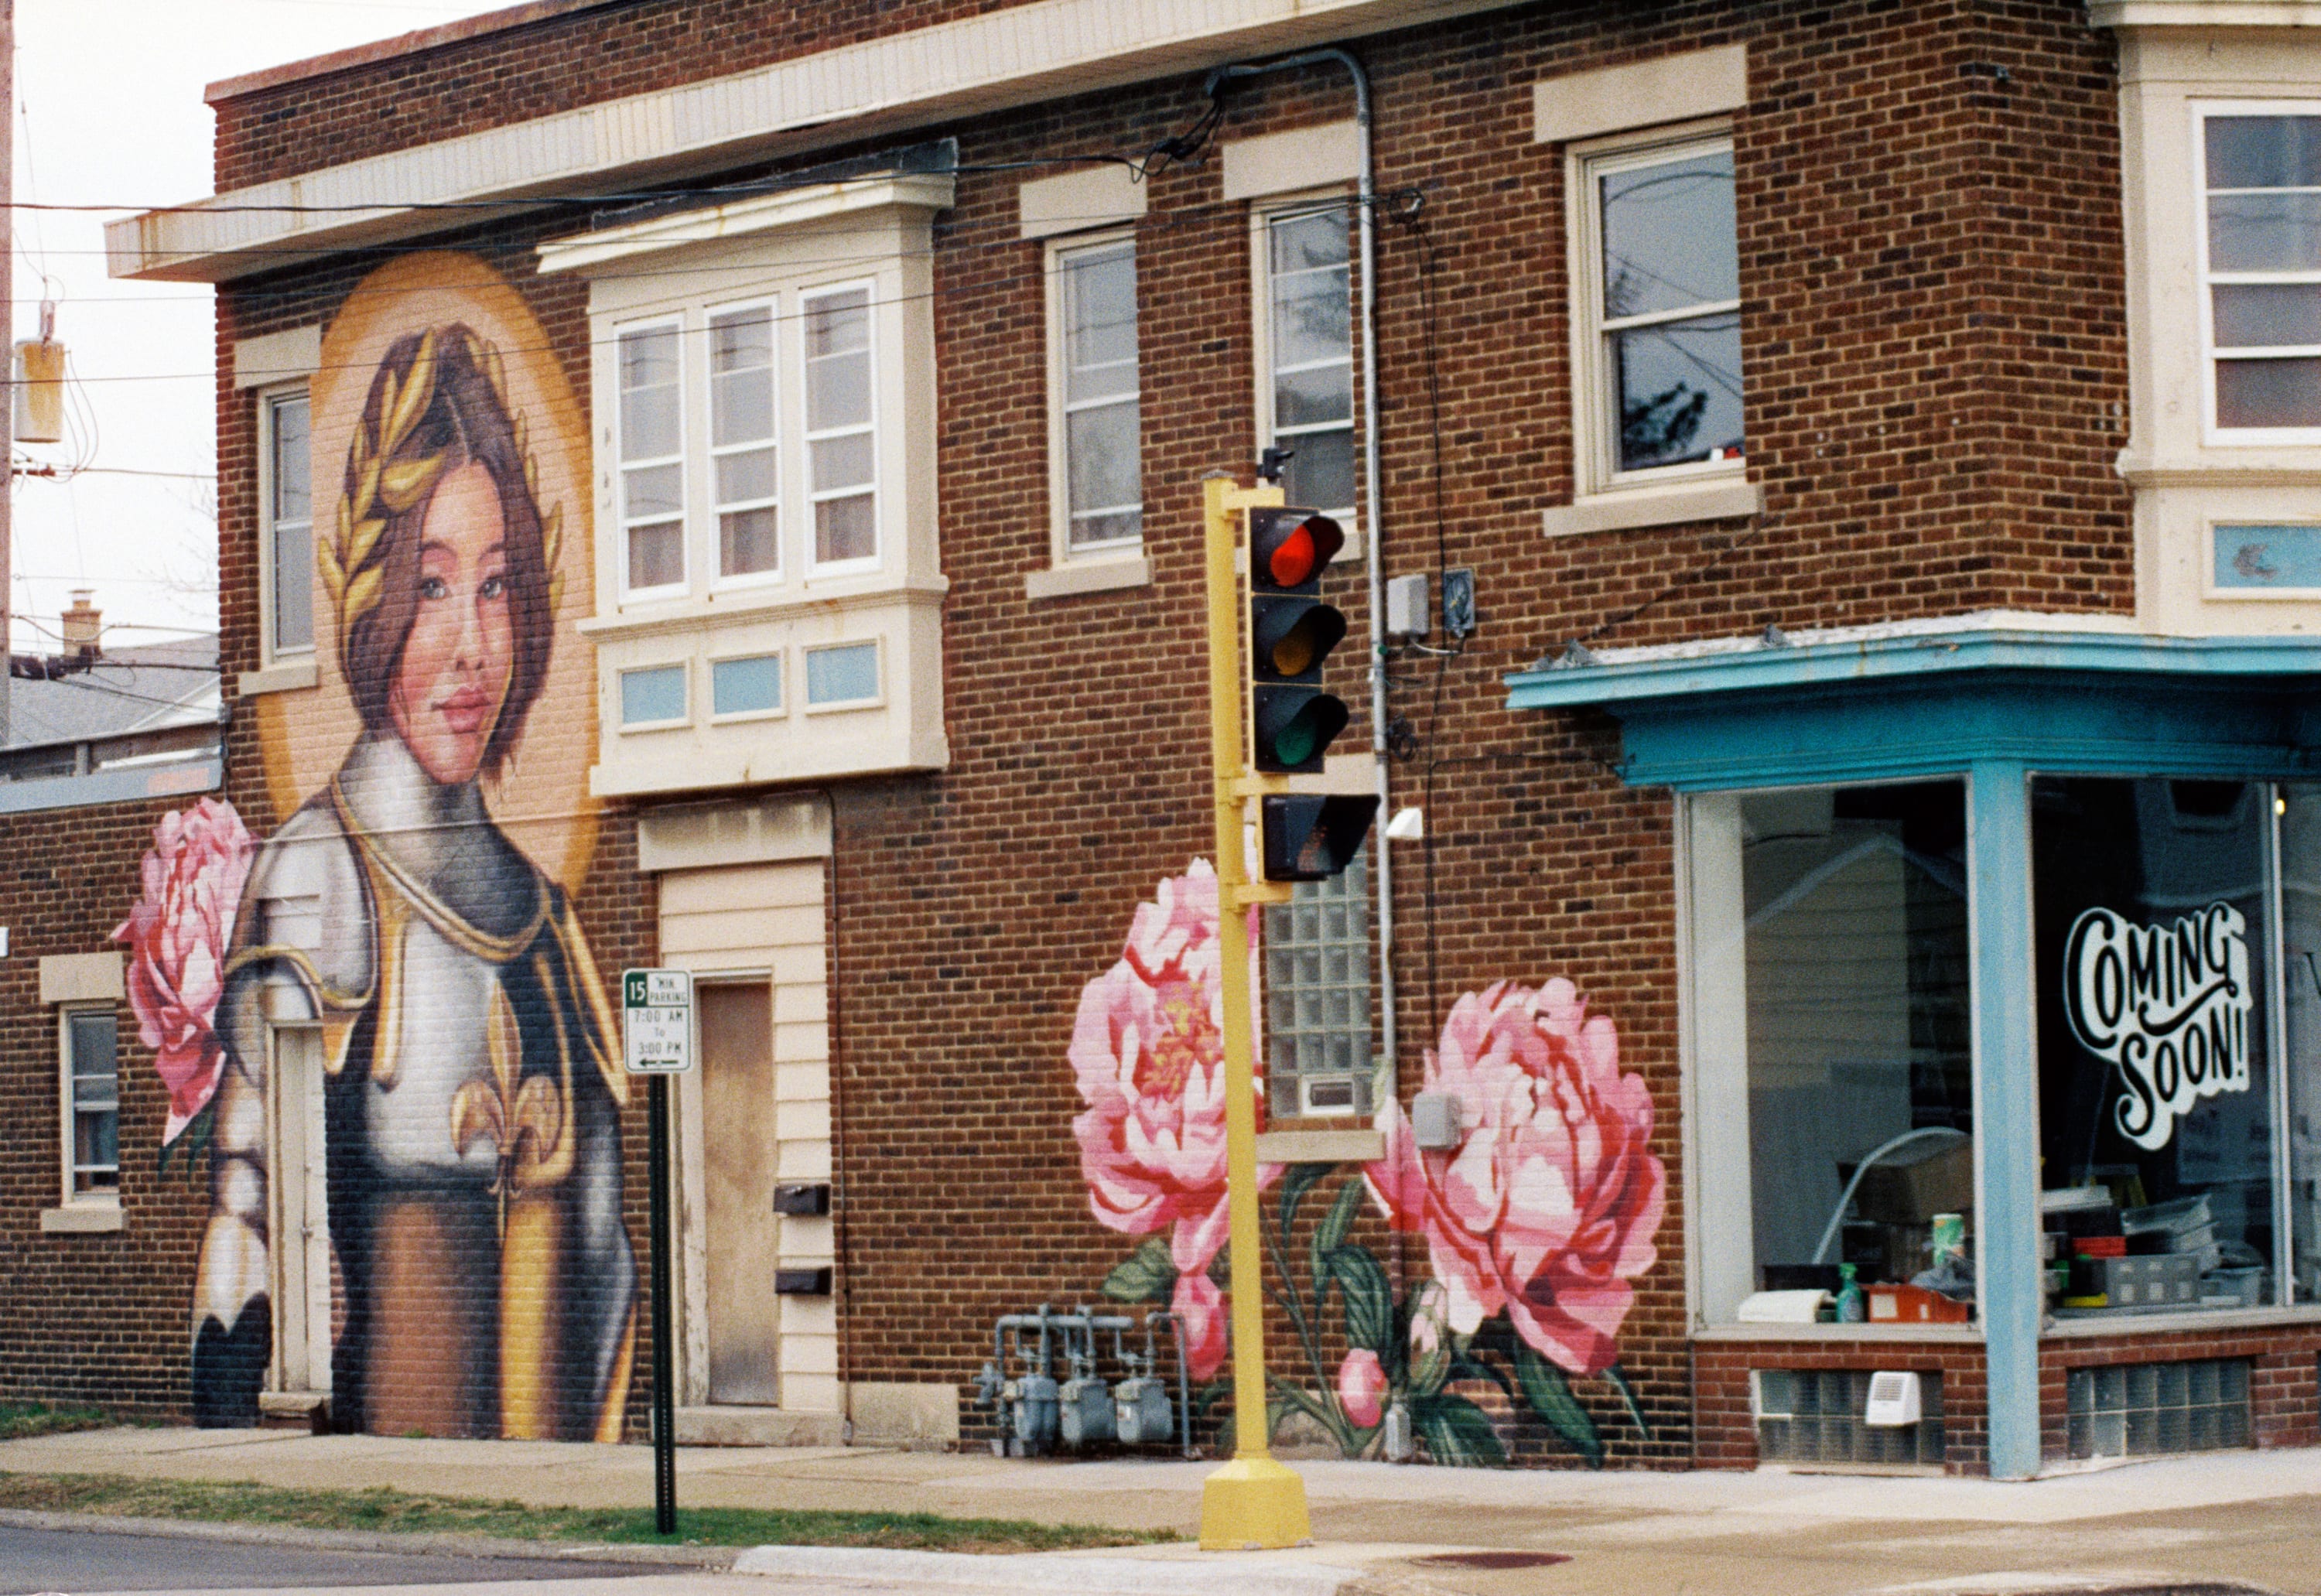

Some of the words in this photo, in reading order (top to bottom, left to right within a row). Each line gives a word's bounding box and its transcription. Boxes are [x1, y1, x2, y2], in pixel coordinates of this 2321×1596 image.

[2066, 904, 2238, 1050] COMING
[631, 981, 646, 1001] 15
[649, 991, 687, 1003] PARKING
[634, 1010, 661, 1023] 7:00
[669, 1010, 683, 1021] AM
[639, 1042, 661, 1054] 3:00
[667, 1042, 682, 1054] PM
[2119, 1003, 2243, 1136] SOON!
